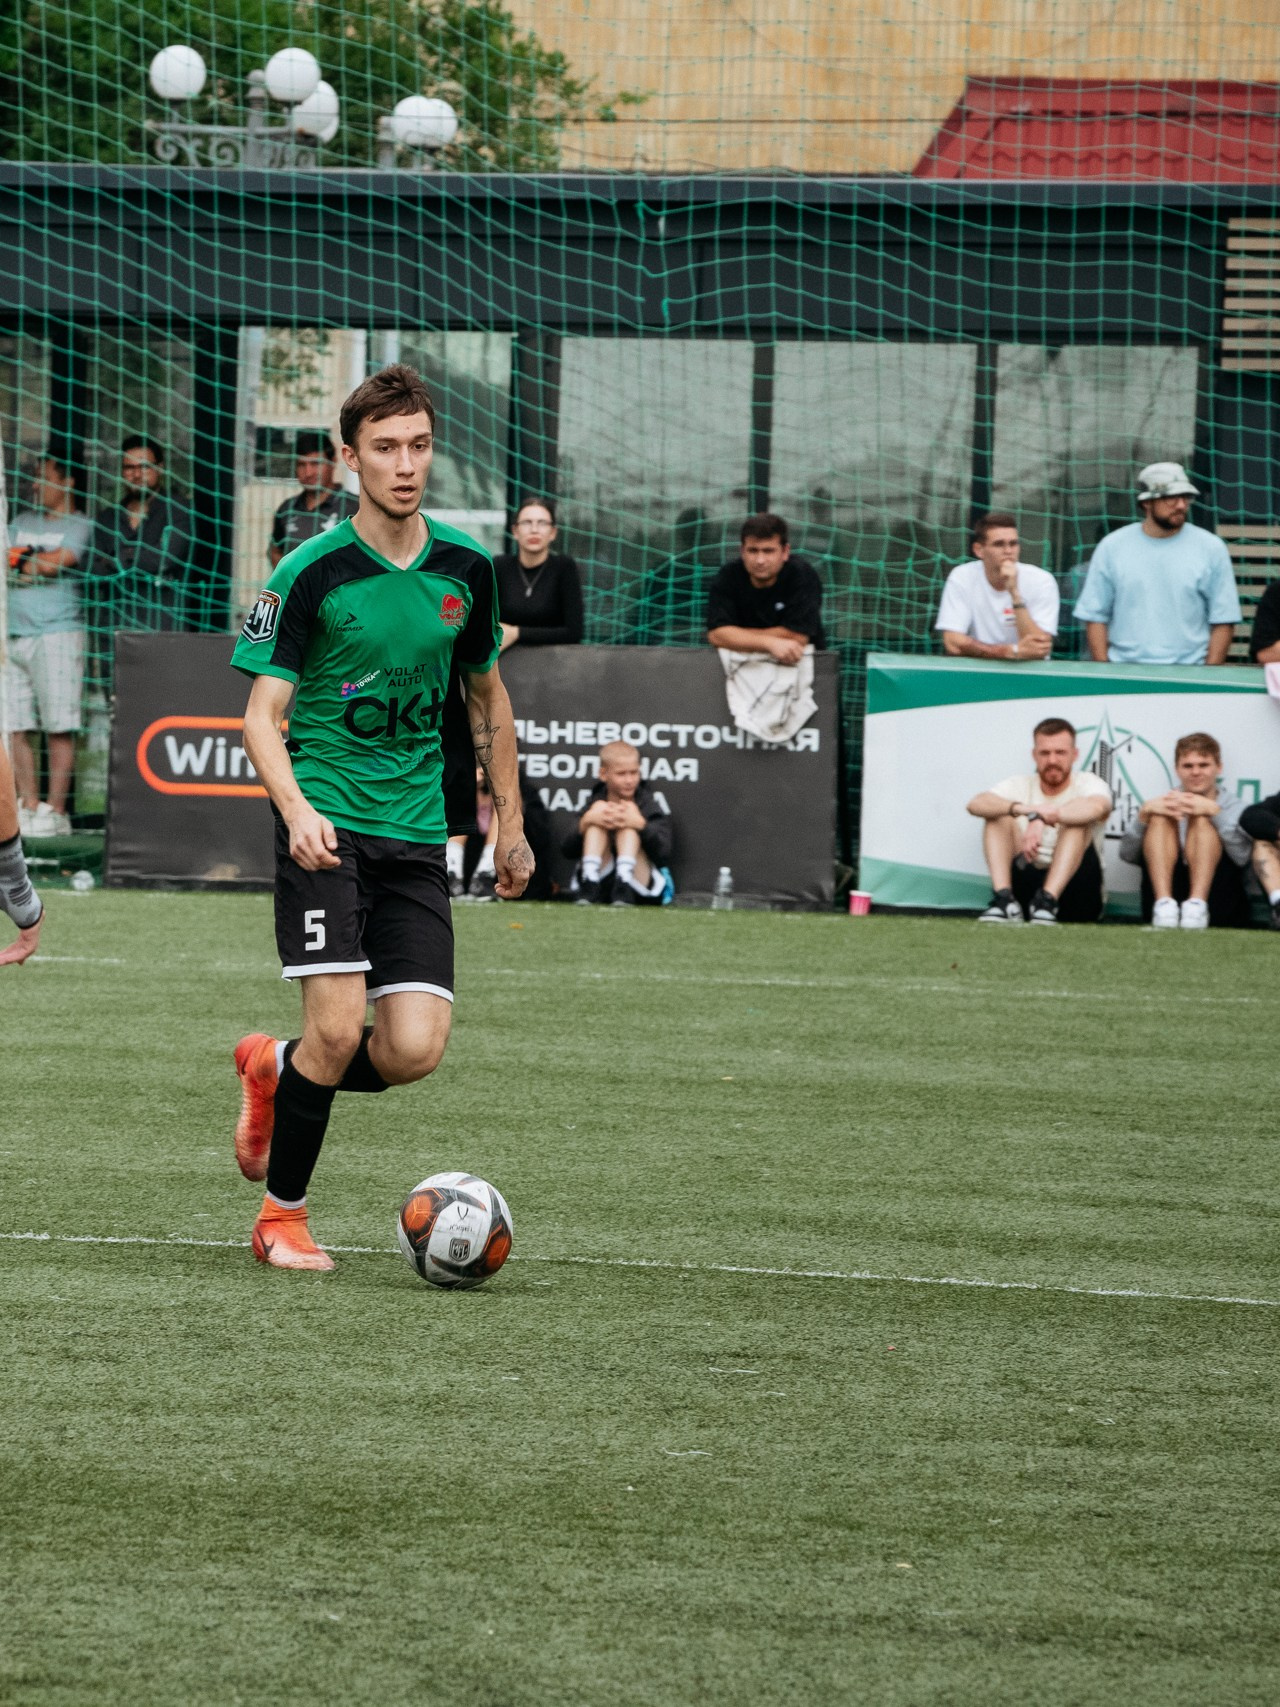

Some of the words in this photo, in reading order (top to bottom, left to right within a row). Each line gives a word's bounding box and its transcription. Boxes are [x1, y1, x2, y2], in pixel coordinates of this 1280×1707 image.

[384, 664, 427, 676] VOLAT
[387, 675, 422, 688] AUTO
[304, 909, 326, 951] 5
